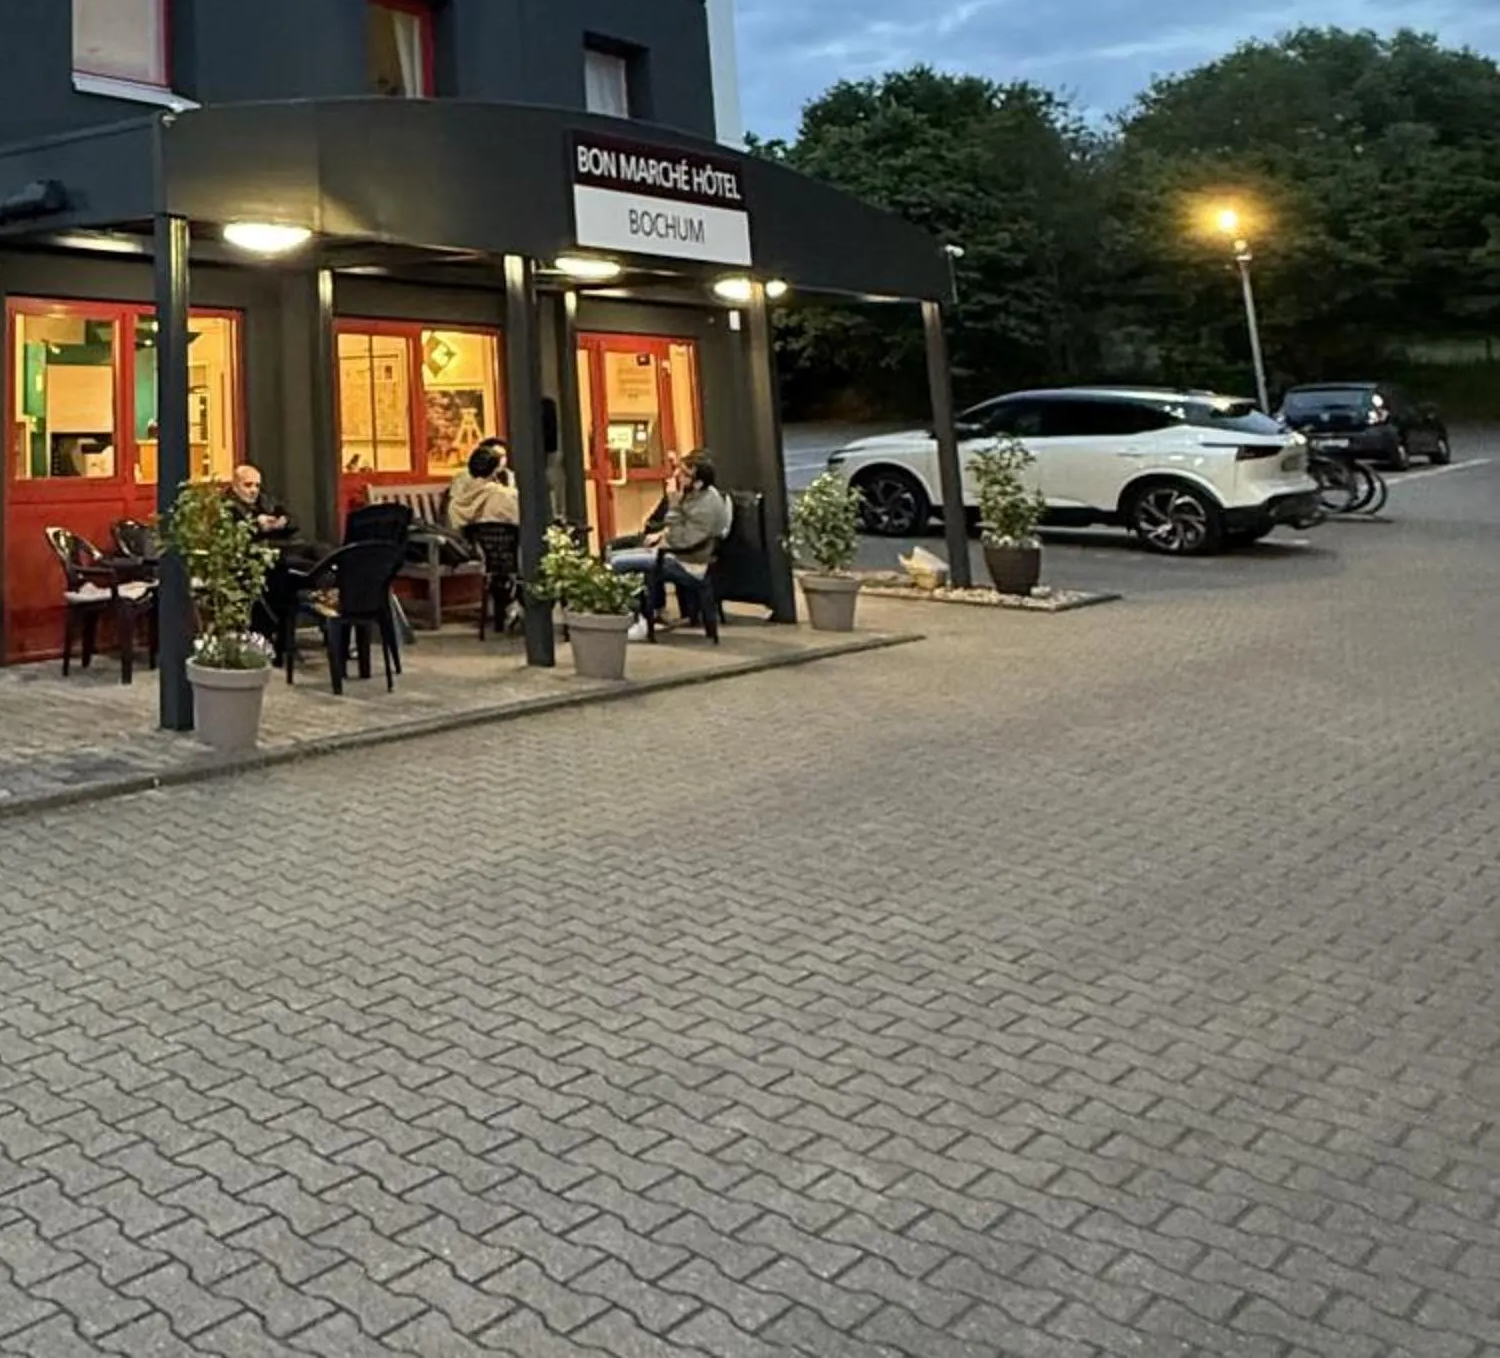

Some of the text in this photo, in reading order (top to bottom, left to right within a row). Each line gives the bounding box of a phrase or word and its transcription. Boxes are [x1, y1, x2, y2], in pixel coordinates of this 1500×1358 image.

[576, 145, 742, 200] BON MARCHÉ HÔTEL
[628, 208, 706, 243] BOCHUM
